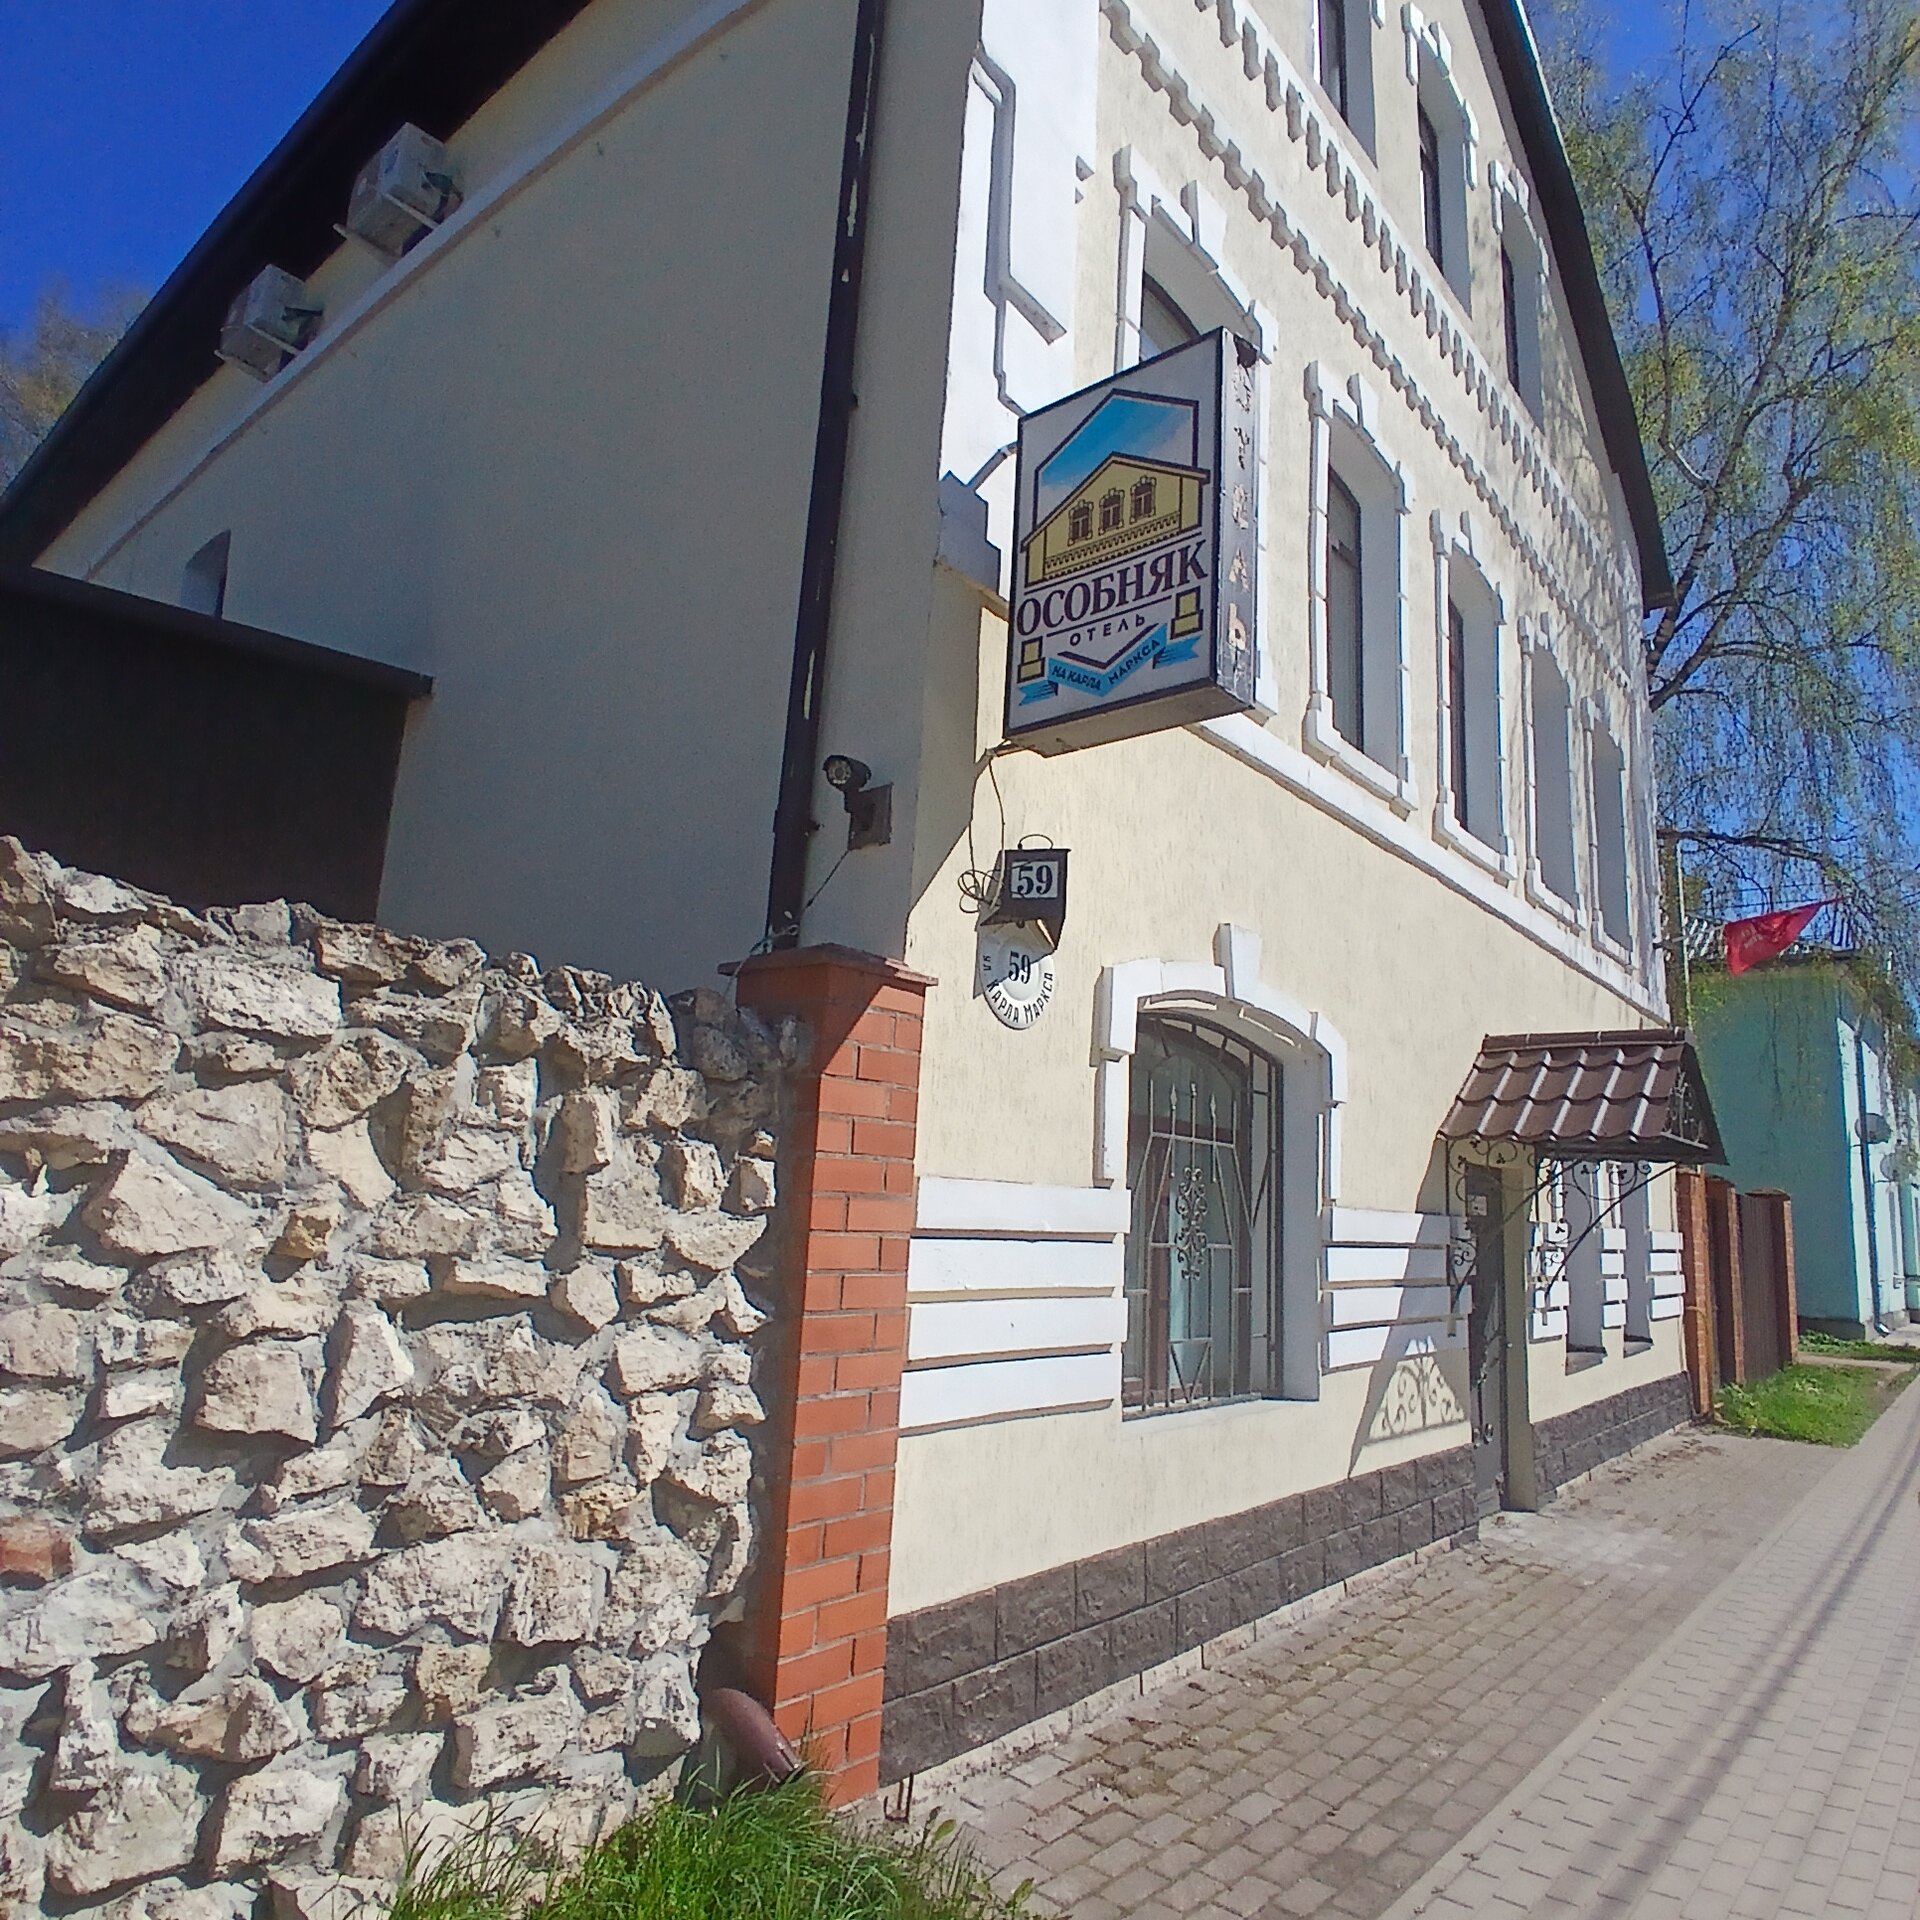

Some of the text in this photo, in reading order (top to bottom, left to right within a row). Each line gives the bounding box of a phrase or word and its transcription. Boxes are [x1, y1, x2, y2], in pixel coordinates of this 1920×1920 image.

[1016, 539, 1208, 636] ОСОБНЯК
[1069, 613, 1146, 646] ОТЕЛЬ
[1051, 639, 1161, 691] НА КАРЛА МАРКСА
[1016, 864, 1054, 896] 59
[1008, 950, 1031, 985] 59
